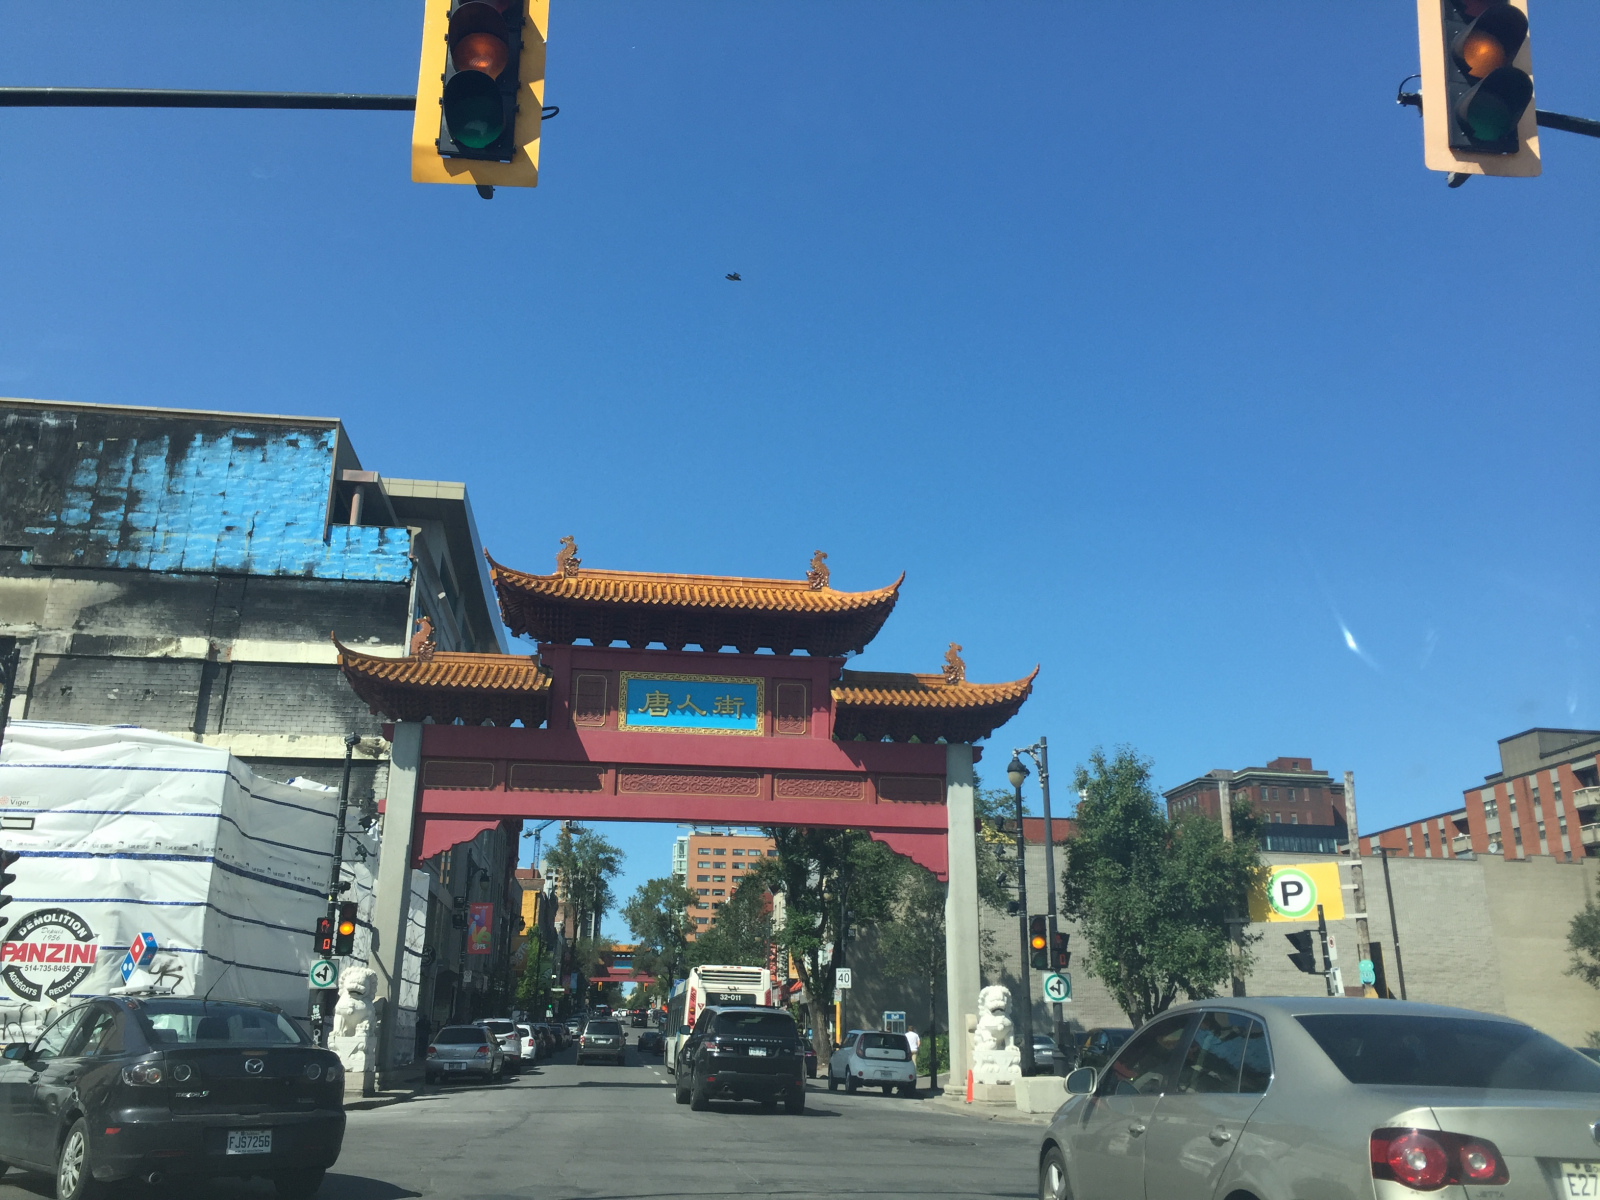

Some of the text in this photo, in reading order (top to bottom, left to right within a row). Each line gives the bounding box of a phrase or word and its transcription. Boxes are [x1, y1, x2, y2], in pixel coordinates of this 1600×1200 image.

[638, 690, 745, 720] 唐人街
[1281, 880, 1304, 906] P
[18, 913, 88, 937] DÉMOLITION
[1, 942, 98, 964] PANZINI
[8, 971, 38, 996] AGRÉGATS
[48, 967, 86, 996] RECYCLAGE
[838, 973, 850, 983] 40
[720, 993, 741, 1001] 32-011
[229, 1135, 271, 1149] FJS7256
